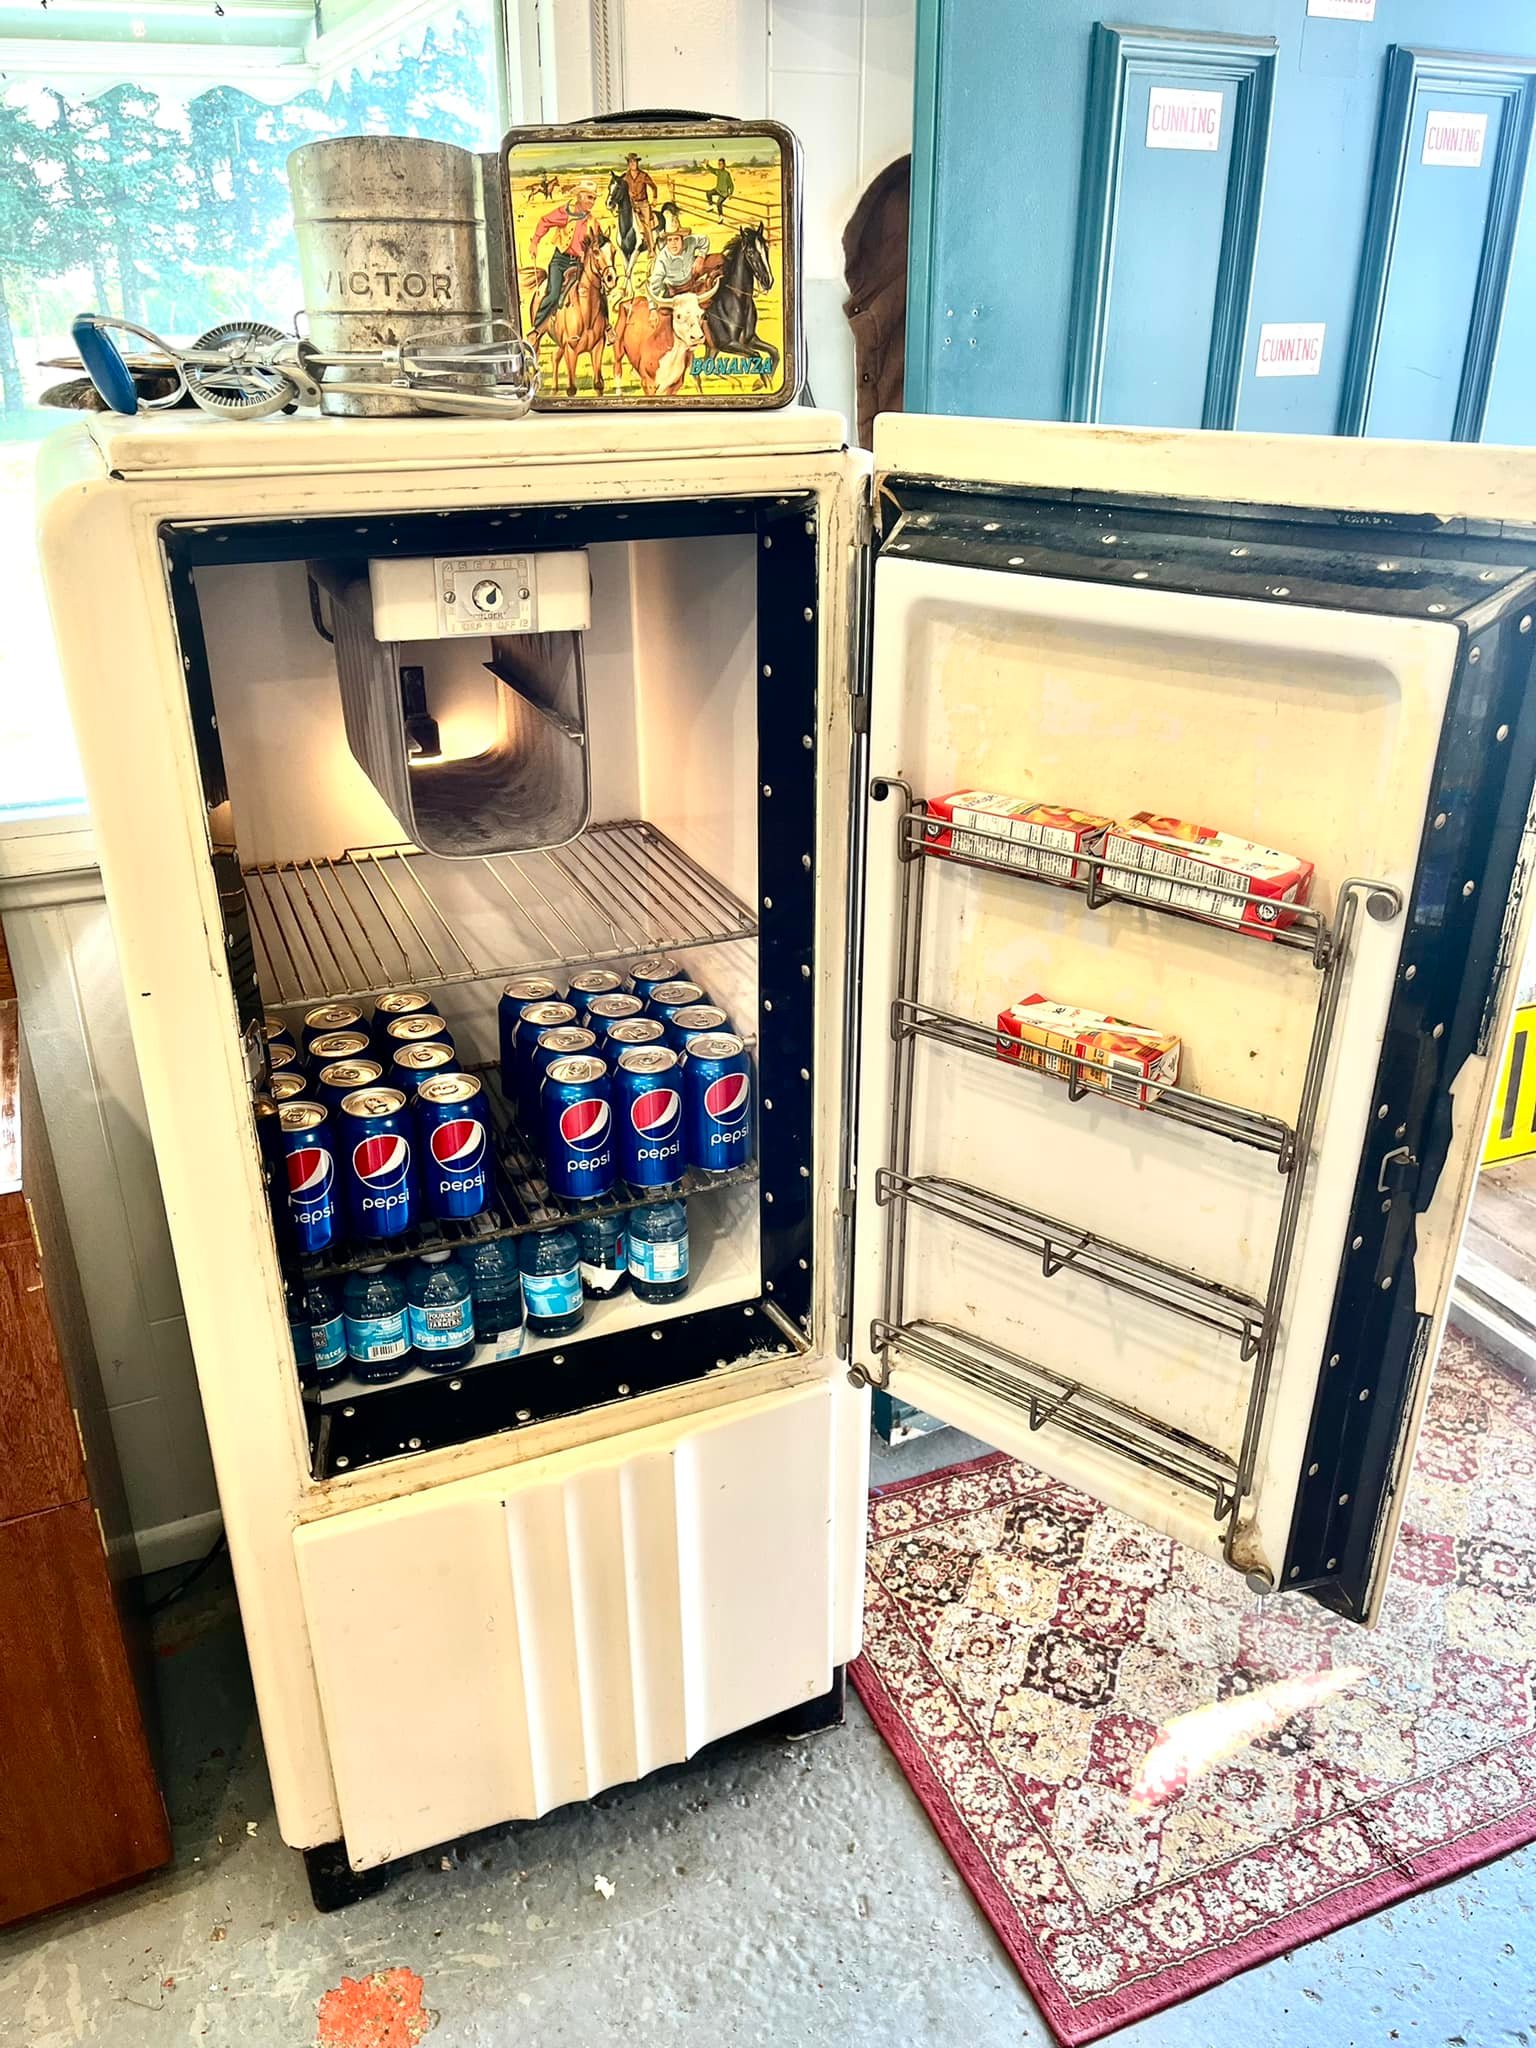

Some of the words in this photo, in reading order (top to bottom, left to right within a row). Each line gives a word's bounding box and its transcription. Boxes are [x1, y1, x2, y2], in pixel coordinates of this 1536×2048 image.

[1152, 104, 1216, 134] CUNNING
[1428, 126, 1481, 152] CUNNING
[321, 270, 451, 299] VICTOR
[1262, 338, 1319, 362] CUNNING
[690, 356, 773, 375] BONANZA
[711, 1125, 749, 1146] pepsi
[567, 1150, 611, 1172] pepsi
[638, 1140, 680, 1161] pepsi
[440, 1171, 486, 1193] pepsi
[363, 1189, 410, 1210] pepsi
[315, 1347, 342, 1361] Water
